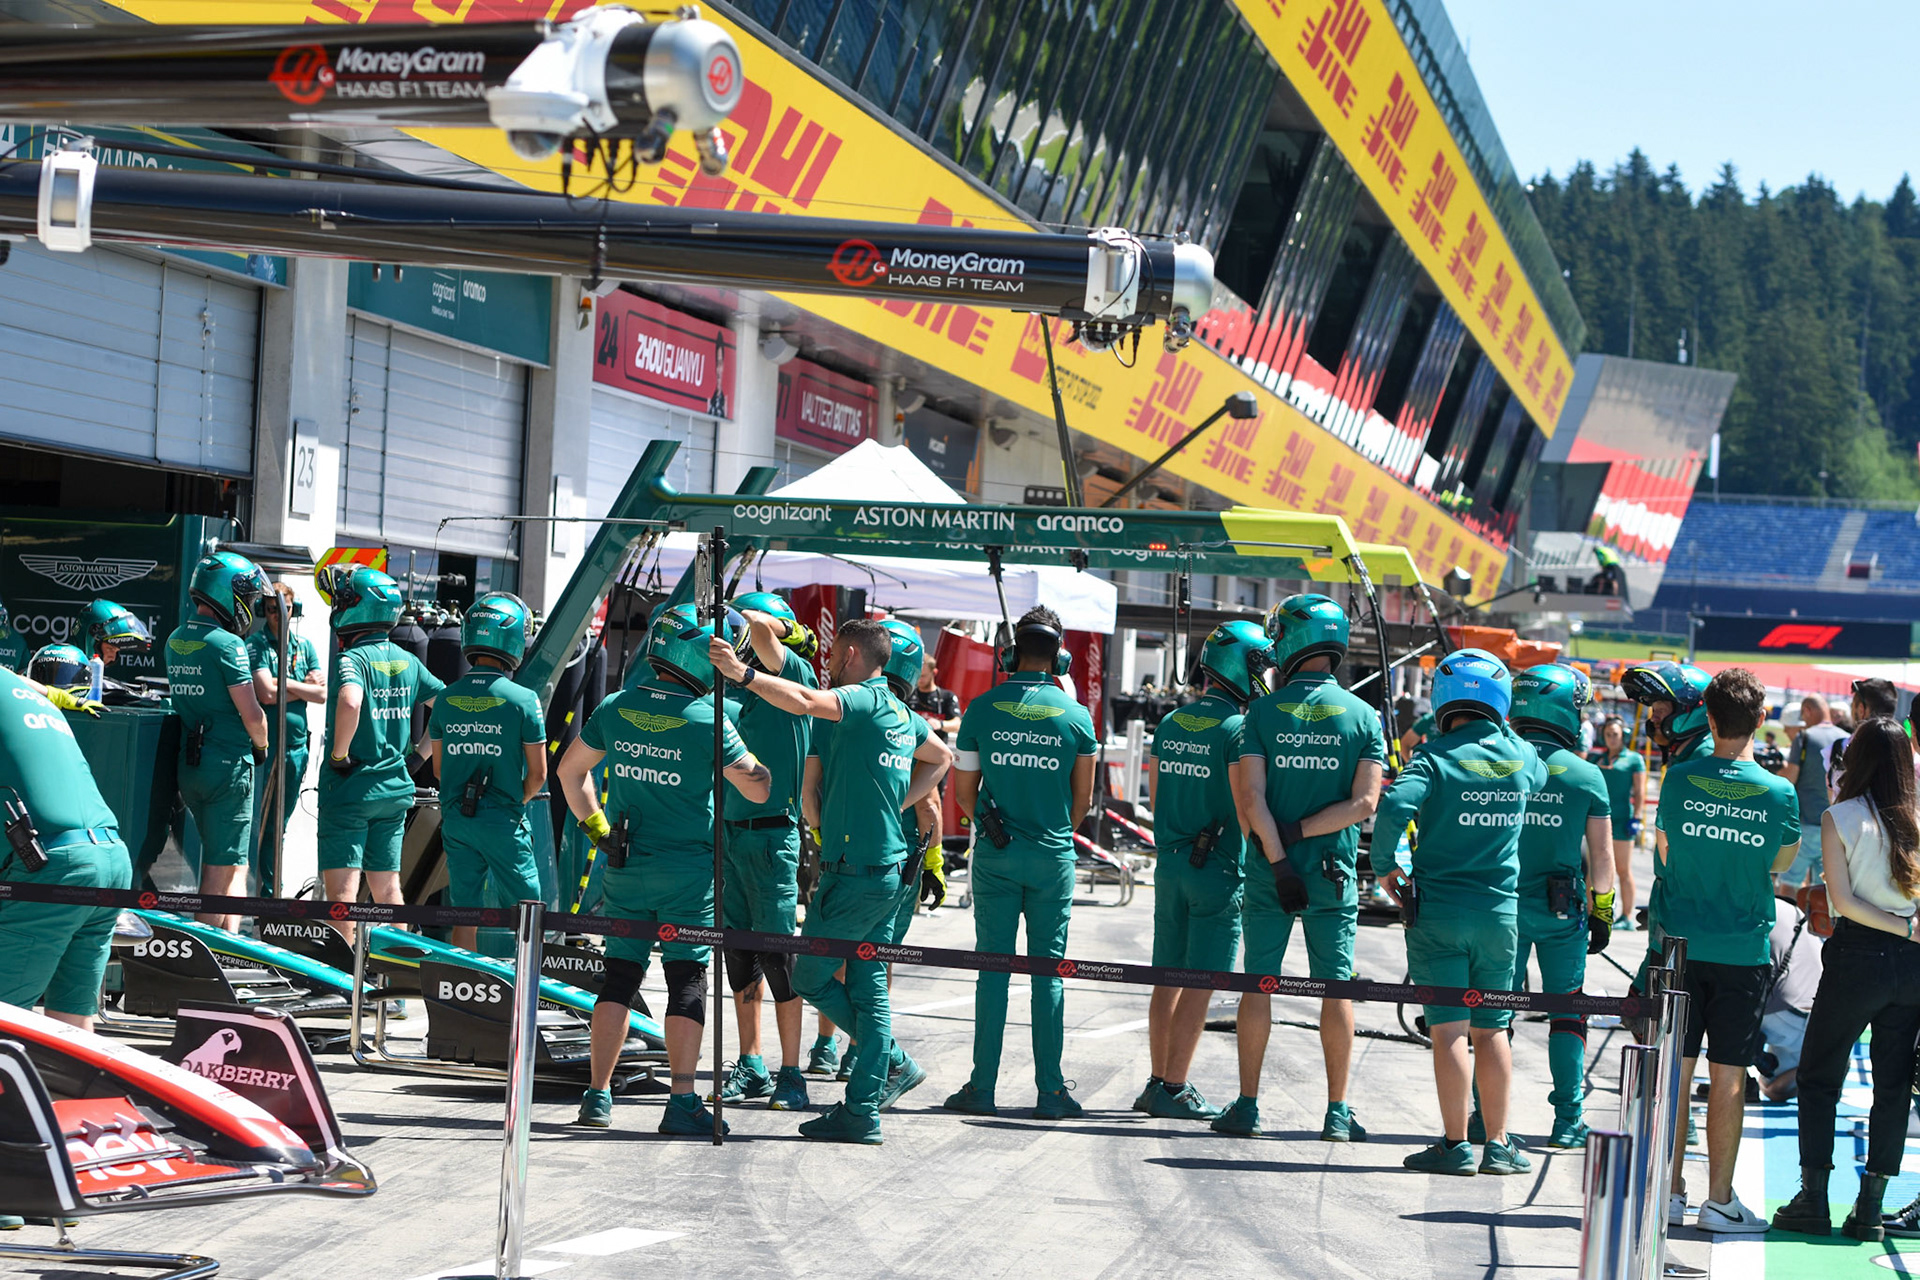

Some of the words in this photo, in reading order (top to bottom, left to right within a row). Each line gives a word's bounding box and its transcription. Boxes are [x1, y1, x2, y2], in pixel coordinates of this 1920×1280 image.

[336, 47, 485, 79] MoneyGram
[336, 82, 395, 98] HAAS
[400, 82, 421, 98] F1
[423, 82, 486, 98] TEAM
[890, 248, 1025, 278] MoneyGram
[432, 281, 456, 304] cognizant
[463, 279, 486, 303] aramco
[888, 274, 941, 287] HAAS
[946, 277, 966, 289] F1
[970, 279, 1024, 292] TEAM
[598, 311, 618, 368] 24
[635, 333, 663, 375] ZHOU
[833, 402, 862, 437] BOTTAS
[299, 446, 315, 489] 23
[733, 502, 832, 525] cognizant
[853, 506, 924, 527] ASTON
[931, 508, 1015, 531] MARTIN
[1037, 514, 1123, 534] aramco
[59, 565, 84, 573] ASTON
[86, 566, 117, 574] MARTIN
[472, 612, 501, 621] aramco
[56, 657, 79, 666] MARTIN
[119, 654, 155, 668] TEAM
[1455, 661, 1491, 671] aramco
[651, 692, 667, 700] BOSS
[446, 721, 503, 737] cognizant
[992, 730, 1062, 748] cognizant
[1162, 739, 1211, 755] cognizant
[1276, 732, 1342, 748] cognizant
[447, 742, 502, 757] aramco
[614, 740, 682, 761] cognizant
[991, 752, 1060, 771] aramco
[1159, 760, 1211, 778] aramco
[1275, 755, 1340, 771] aramco
[614, 763, 682, 786] aramco
[1683, 799, 1768, 823] cognizant
[1682, 822, 1765, 848] aramco
[158, 894, 202, 905] MoneyGram
[350, 905, 393, 915] MoneyGram
[263, 923, 330, 940] AVATRADE
[678, 927, 723, 939] MoneyGram
[133, 939, 193, 959] BOSS
[877, 945, 923, 957] MoneyGram
[215, 953, 264, 970] D-PERREGAUX
[542, 955, 607, 972] AVATRAD
[1077, 963, 1124, 974] MoneyGram
[439, 980, 501, 1003] BOSS
[1279, 979, 1326, 989] MoneyGram
[1483, 992, 1530, 1003] MoneyGram
[180, 1059, 296, 1091] OAKBERRY
